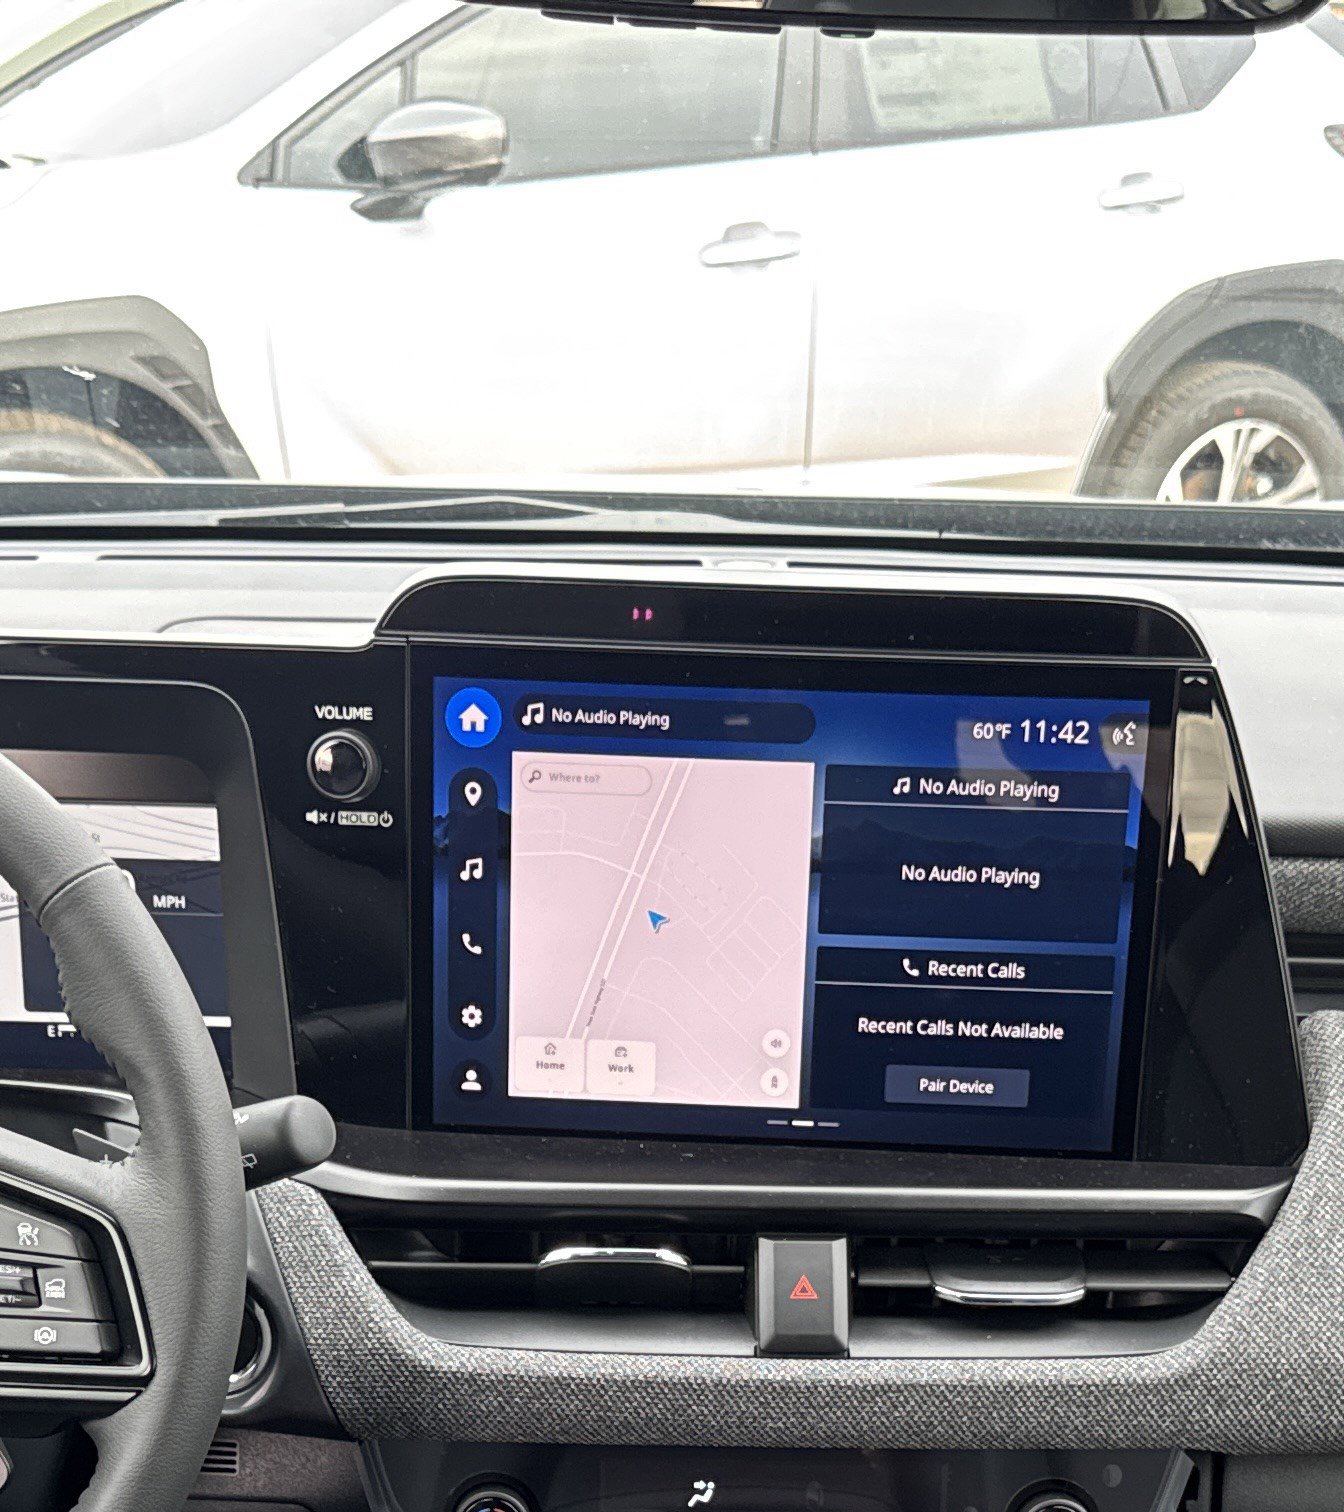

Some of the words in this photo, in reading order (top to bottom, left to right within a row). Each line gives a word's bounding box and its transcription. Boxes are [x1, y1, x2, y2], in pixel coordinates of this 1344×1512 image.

[314, 705, 374, 721] VOLUME
[551, 707, 573, 723] No
[574, 709, 617, 725] Audio
[619, 709, 671, 731] Playing
[1020, 718, 1090, 745] 11:42
[548, 771, 582, 783] Where
[584, 773, 601, 784] to?
[919, 777, 944, 795] No
[946, 778, 996, 797] Audio
[999, 779, 1060, 803] Playing
[339, 812, 377, 825] HOLD
[901, 863, 926, 882] No
[928, 865, 978, 884] Audio
[981, 867, 1041, 889] Playing
[152, 894, 186, 909] MPH
[927, 959, 985, 979] Recent
[987, 961, 1026, 980] Calls
[857, 1016, 914, 1035] Recent
[916, 1018, 954, 1037] Calls
[957, 1020, 989, 1038] Not
[990, 1021, 1065, 1041] Available
[535, 1060, 566, 1071] Home
[607, 1063, 635, 1074] Work
[918, 1077, 946, 1093] Pair
[948, 1078, 996, 1095] Device
